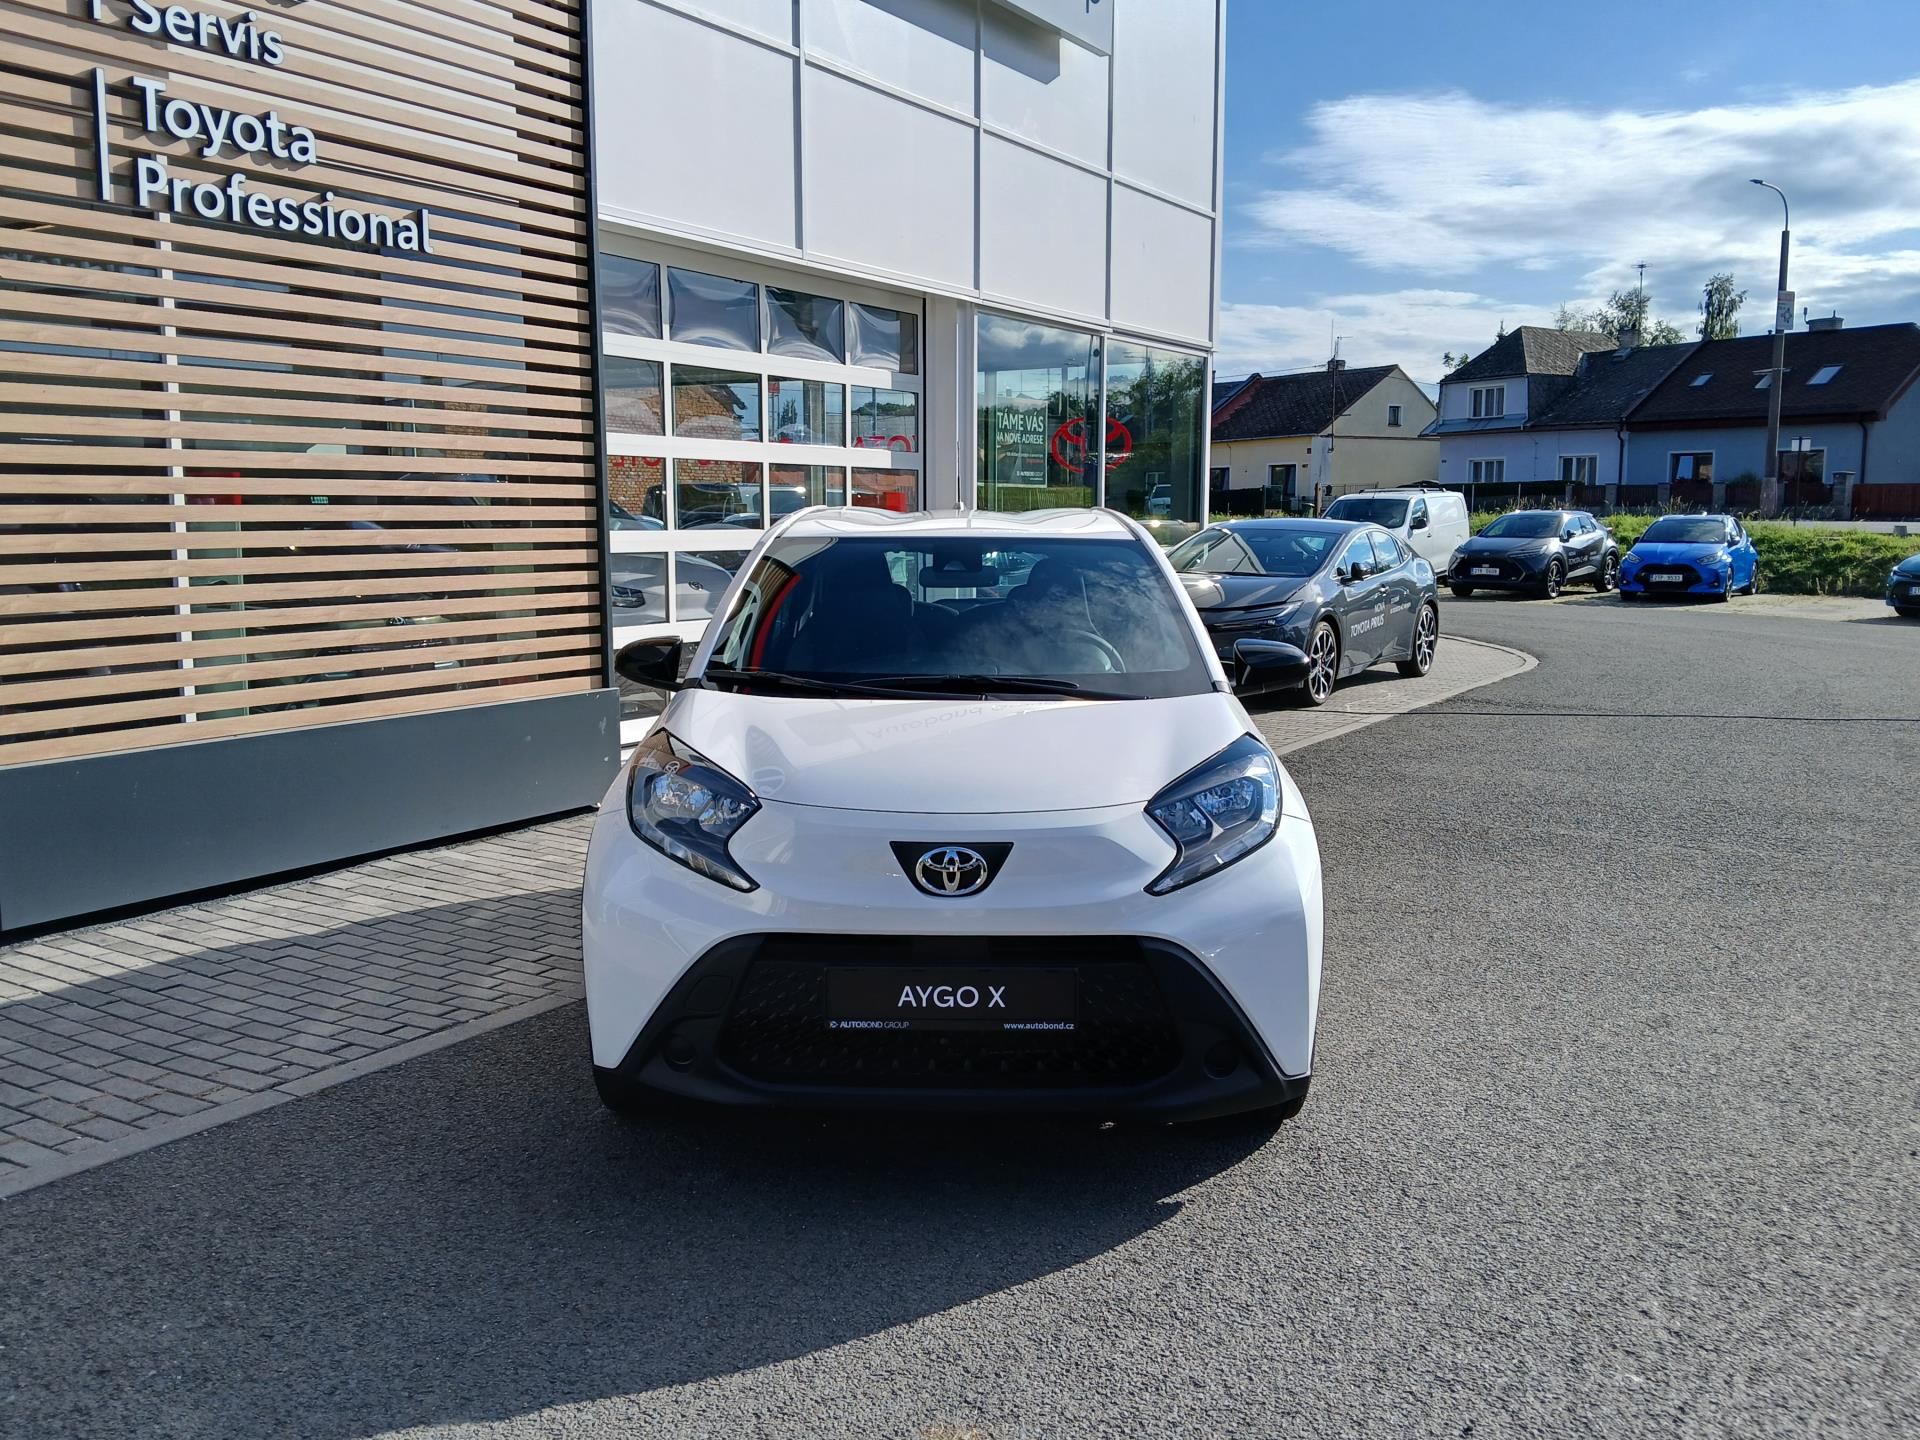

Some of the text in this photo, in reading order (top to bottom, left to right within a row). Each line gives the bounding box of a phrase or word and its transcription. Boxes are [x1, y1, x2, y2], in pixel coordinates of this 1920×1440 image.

[130, 0, 285, 65] Servis
[131, 76, 317, 164] Toyota
[136, 157, 434, 254] Professional
[1025, 412, 1044, 432] VÁS
[1021, 433, 1044, 445] ADRESE
[1350, 619, 1371, 638] TOYOTA
[897, 986, 1006, 1008] AYGO X
[839, 1021, 910, 1029] AUTOBOND GROUP
[1003, 1022, 1075, 1030] www.autobond.cz
